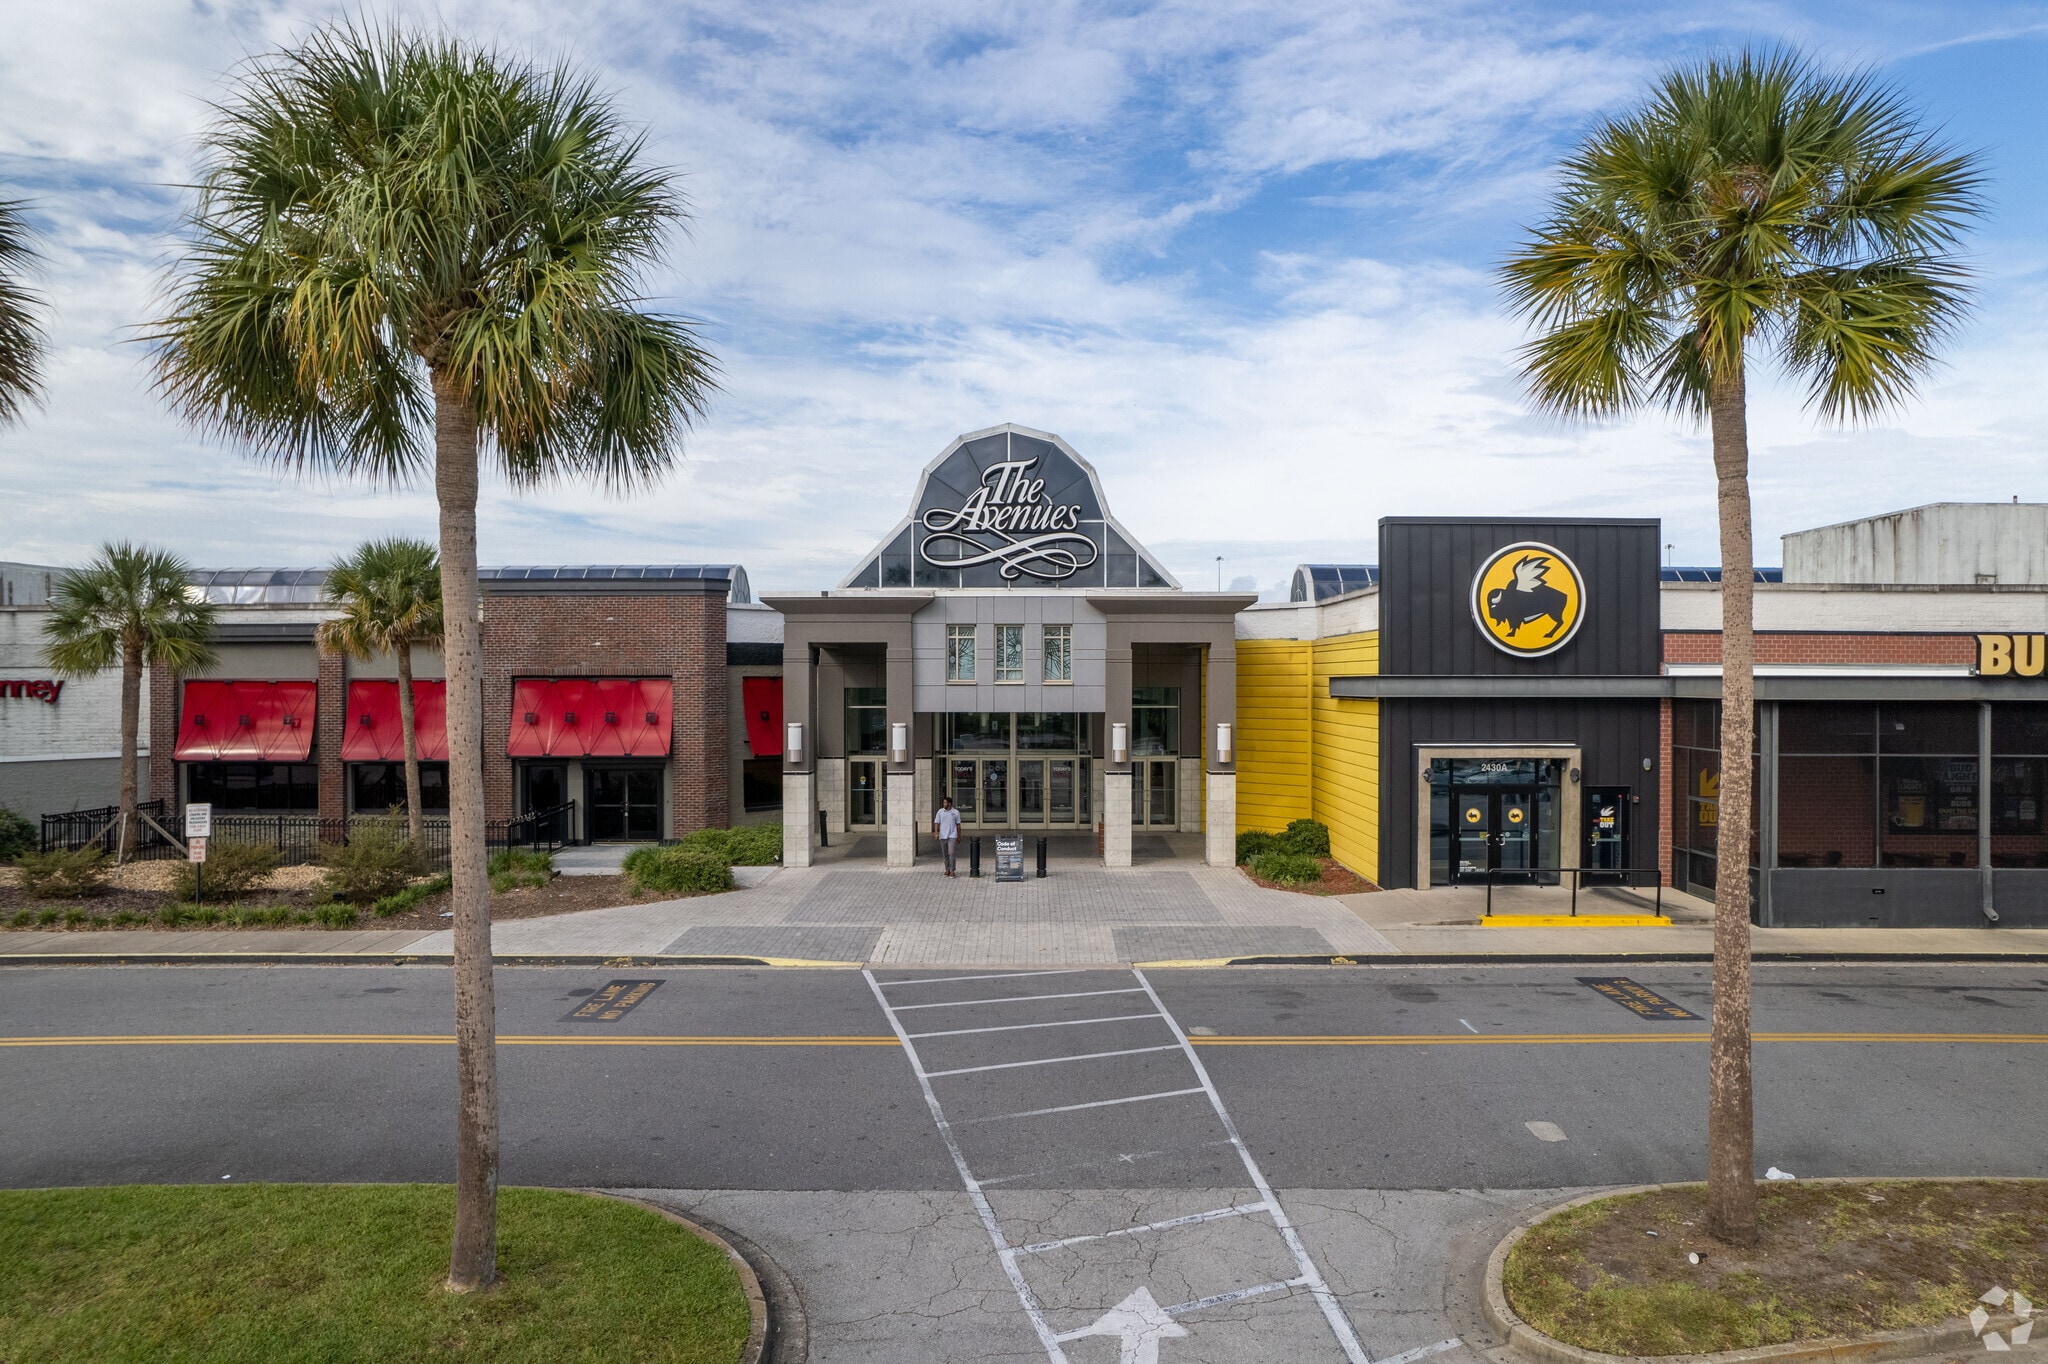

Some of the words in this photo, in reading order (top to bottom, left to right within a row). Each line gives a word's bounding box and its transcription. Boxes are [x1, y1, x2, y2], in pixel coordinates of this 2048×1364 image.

[980, 455, 1045, 505] The
[923, 486, 1082, 533] Avenues
[1977, 634, 2046, 676] BU
[1481, 763, 1508, 772] 2430A
[572, 1002, 607, 1017] FIRE
[594, 984, 628, 1001] LANE
[598, 1009, 624, 1020] NO
[613, 982, 657, 1008] PARKING
[1663, 1007, 1692, 1018] NO
